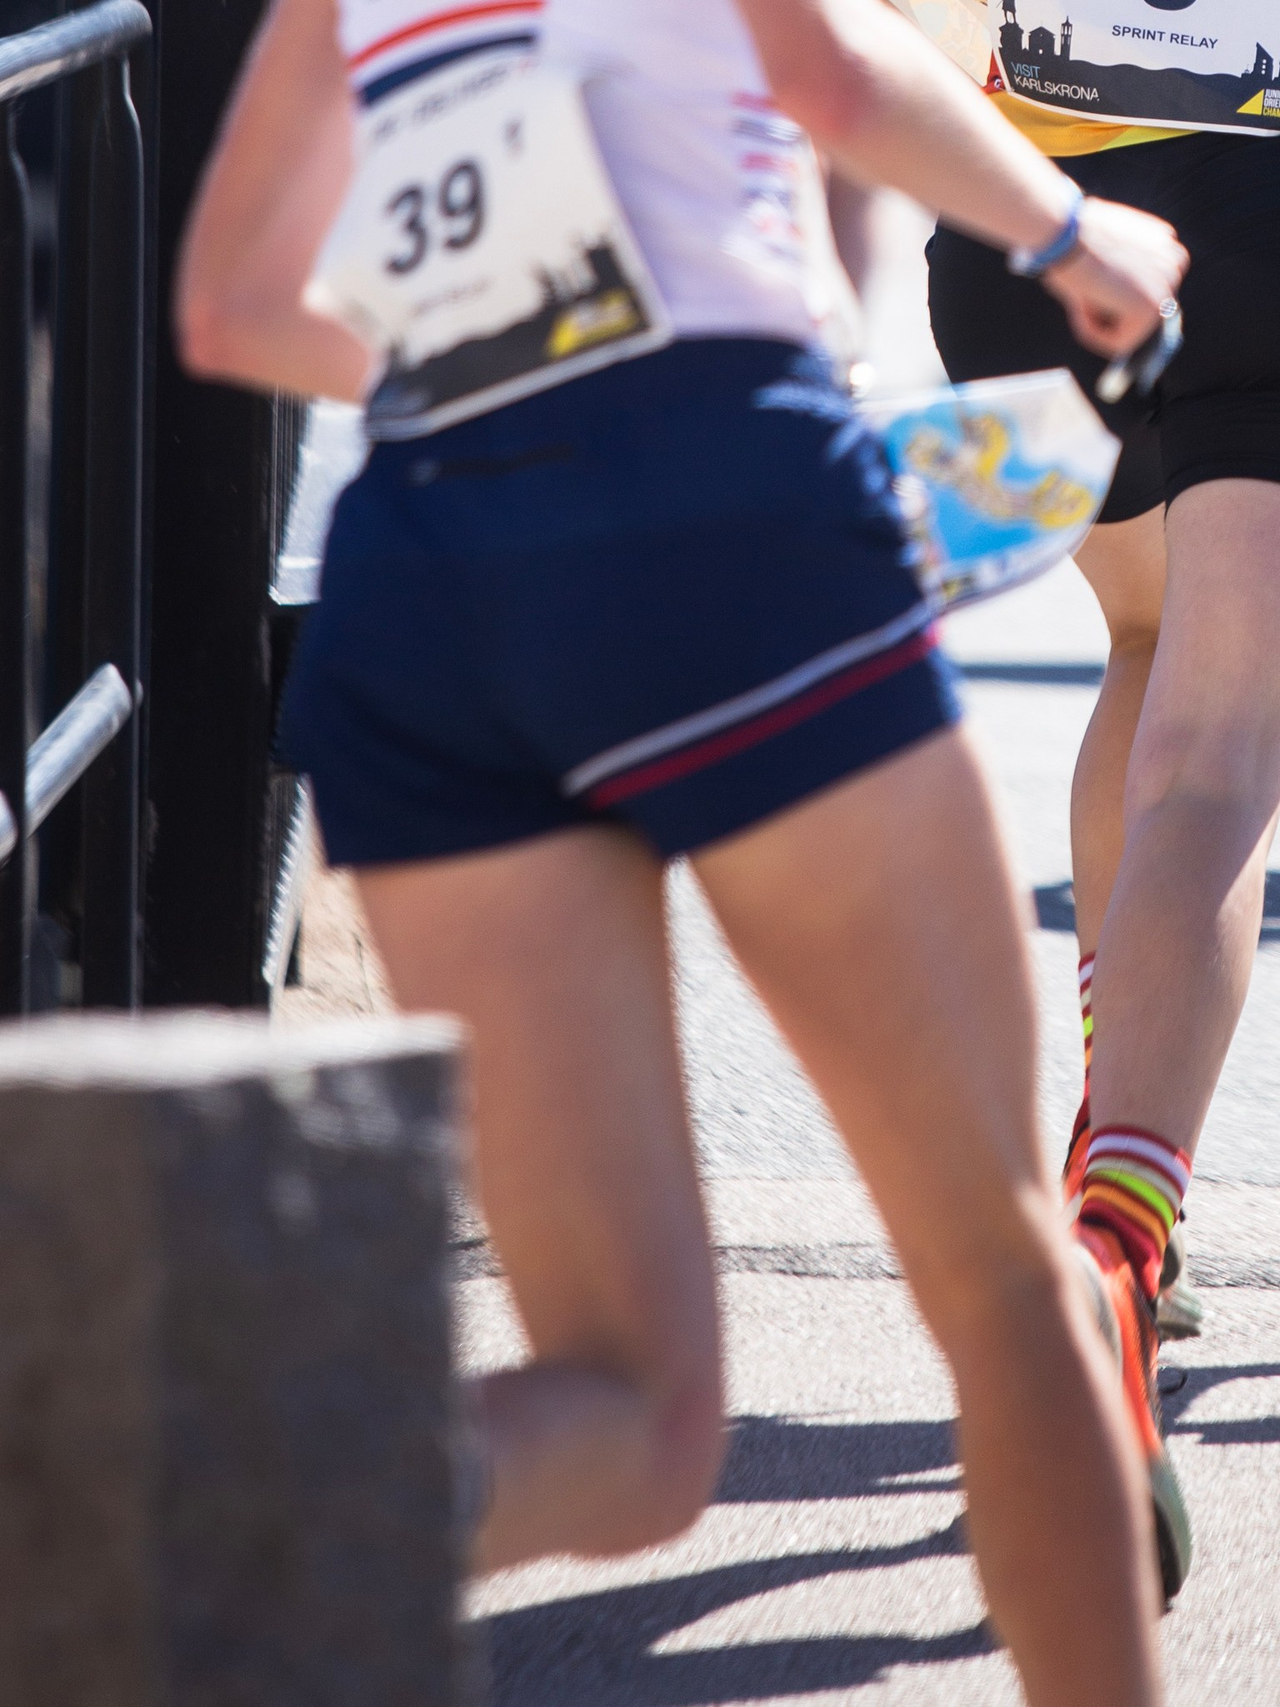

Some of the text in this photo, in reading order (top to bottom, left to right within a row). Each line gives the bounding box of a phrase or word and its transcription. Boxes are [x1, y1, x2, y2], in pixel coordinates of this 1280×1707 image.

[1111, 25, 1218, 49] SPRINT RELAY
[1011, 62, 1041, 79] VISIT
[383, 156, 487, 276] 39
